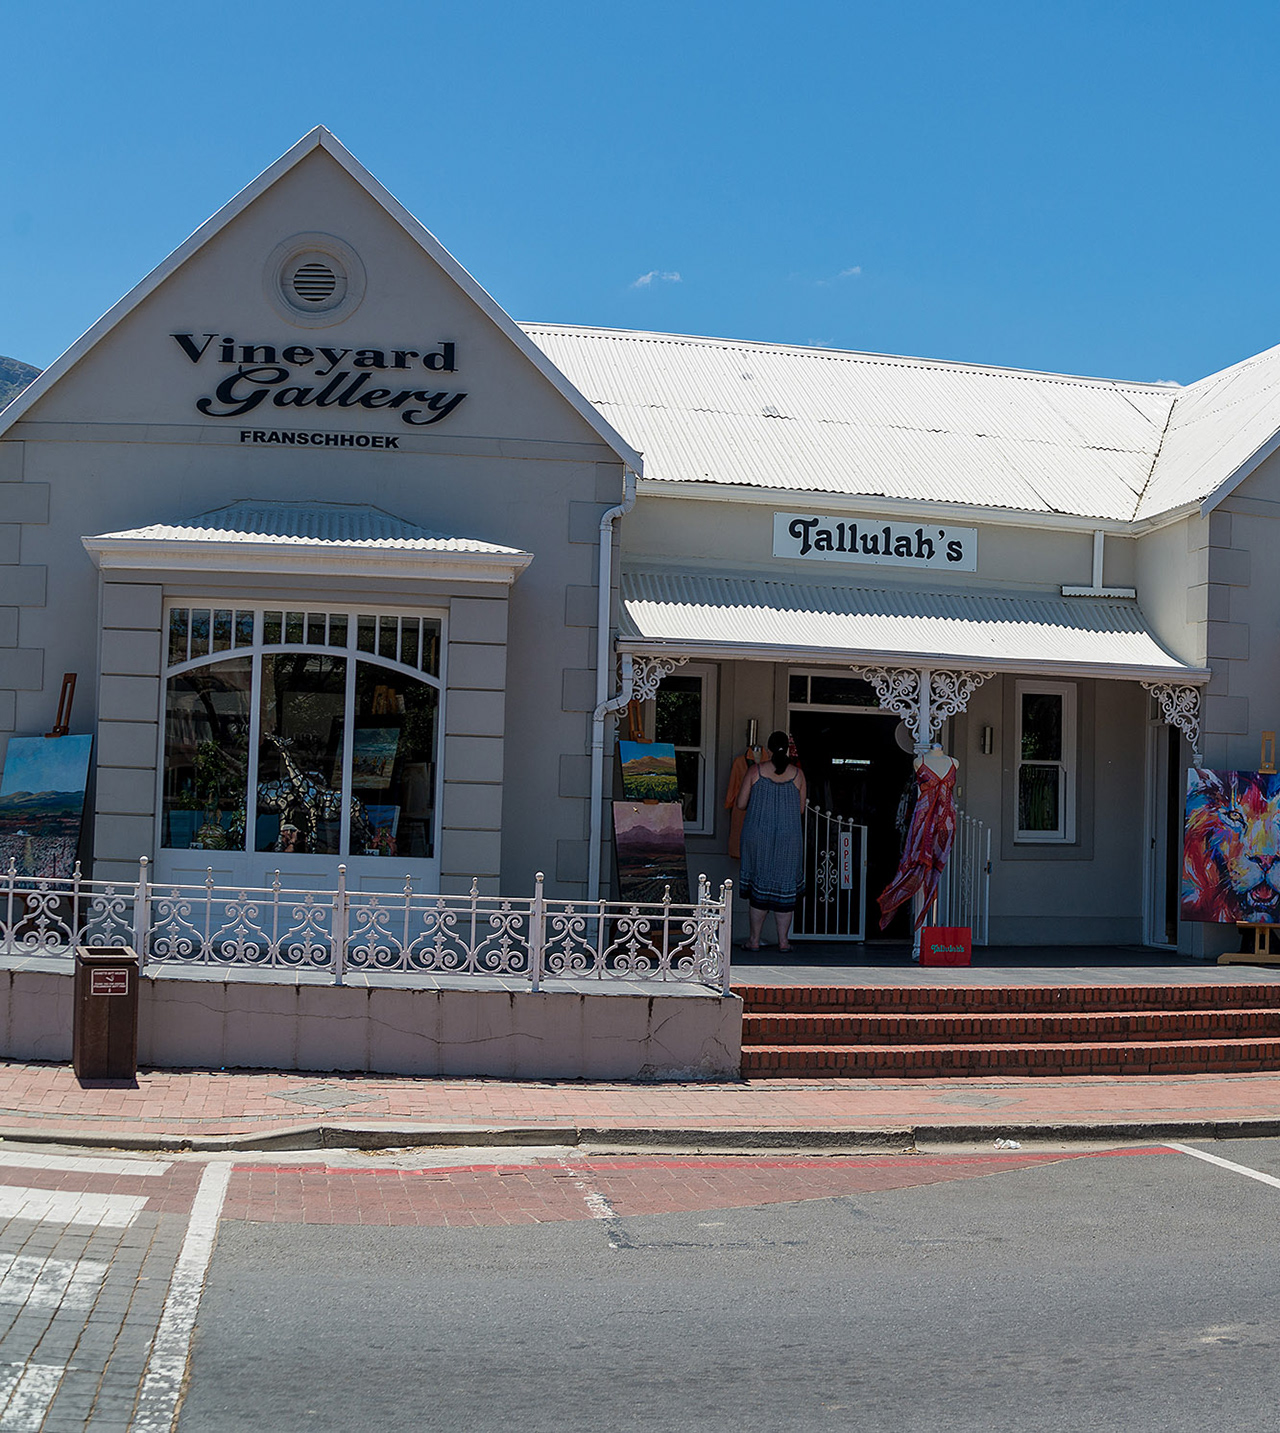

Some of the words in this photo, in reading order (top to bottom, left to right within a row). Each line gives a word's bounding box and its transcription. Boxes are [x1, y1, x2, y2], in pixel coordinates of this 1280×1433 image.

[169, 333, 459, 376] Vineyard
[195, 364, 469, 426] Gallery
[239, 430, 400, 449] FRANSCHHOEK
[788, 517, 964, 562] Tallulah's
